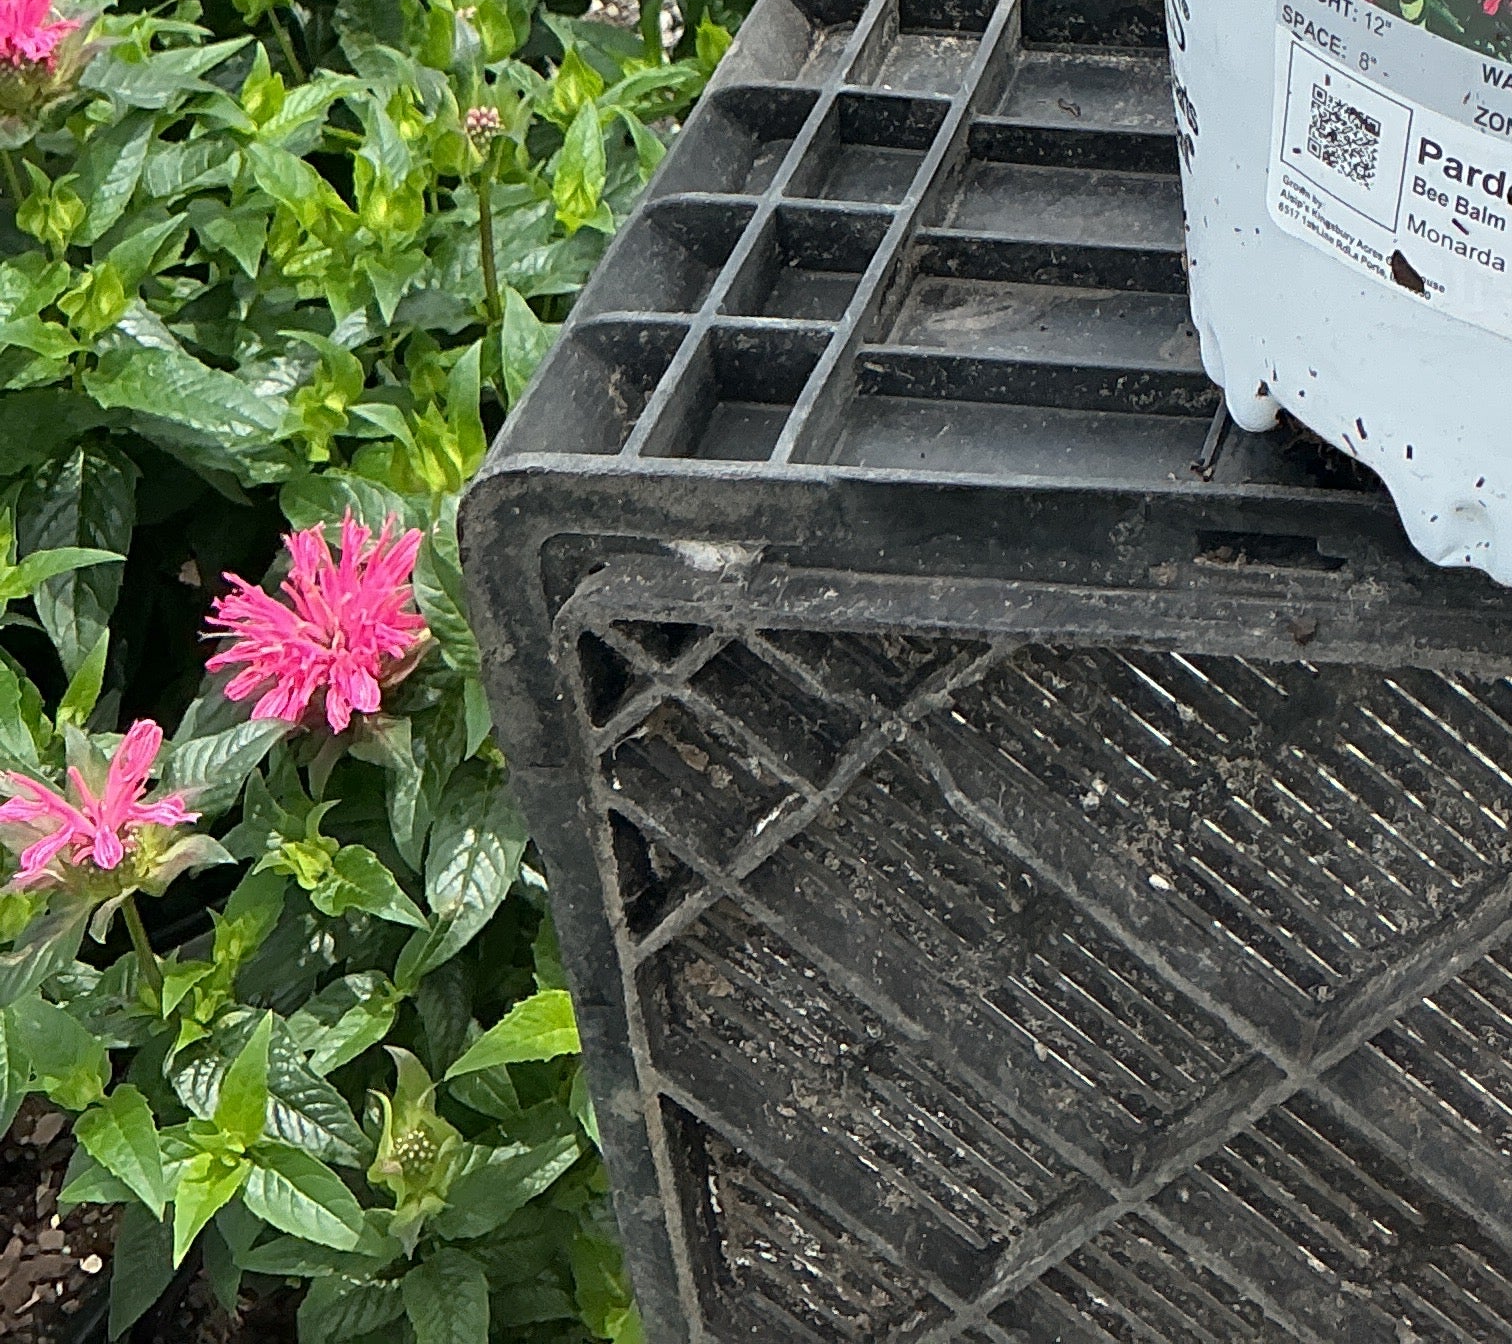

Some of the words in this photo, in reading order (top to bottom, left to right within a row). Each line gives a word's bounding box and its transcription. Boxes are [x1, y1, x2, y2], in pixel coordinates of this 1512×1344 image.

[1282, 4, 1347, 59] SPACE:
[1358, 51, 1378, 71] 8"
[1365, 11, 1392, 37] 12"
[1413, 176, 1449, 207] Bee
[1455, 195, 1506, 232] Balm
[1407, 214, 1505, 272] Monarda
